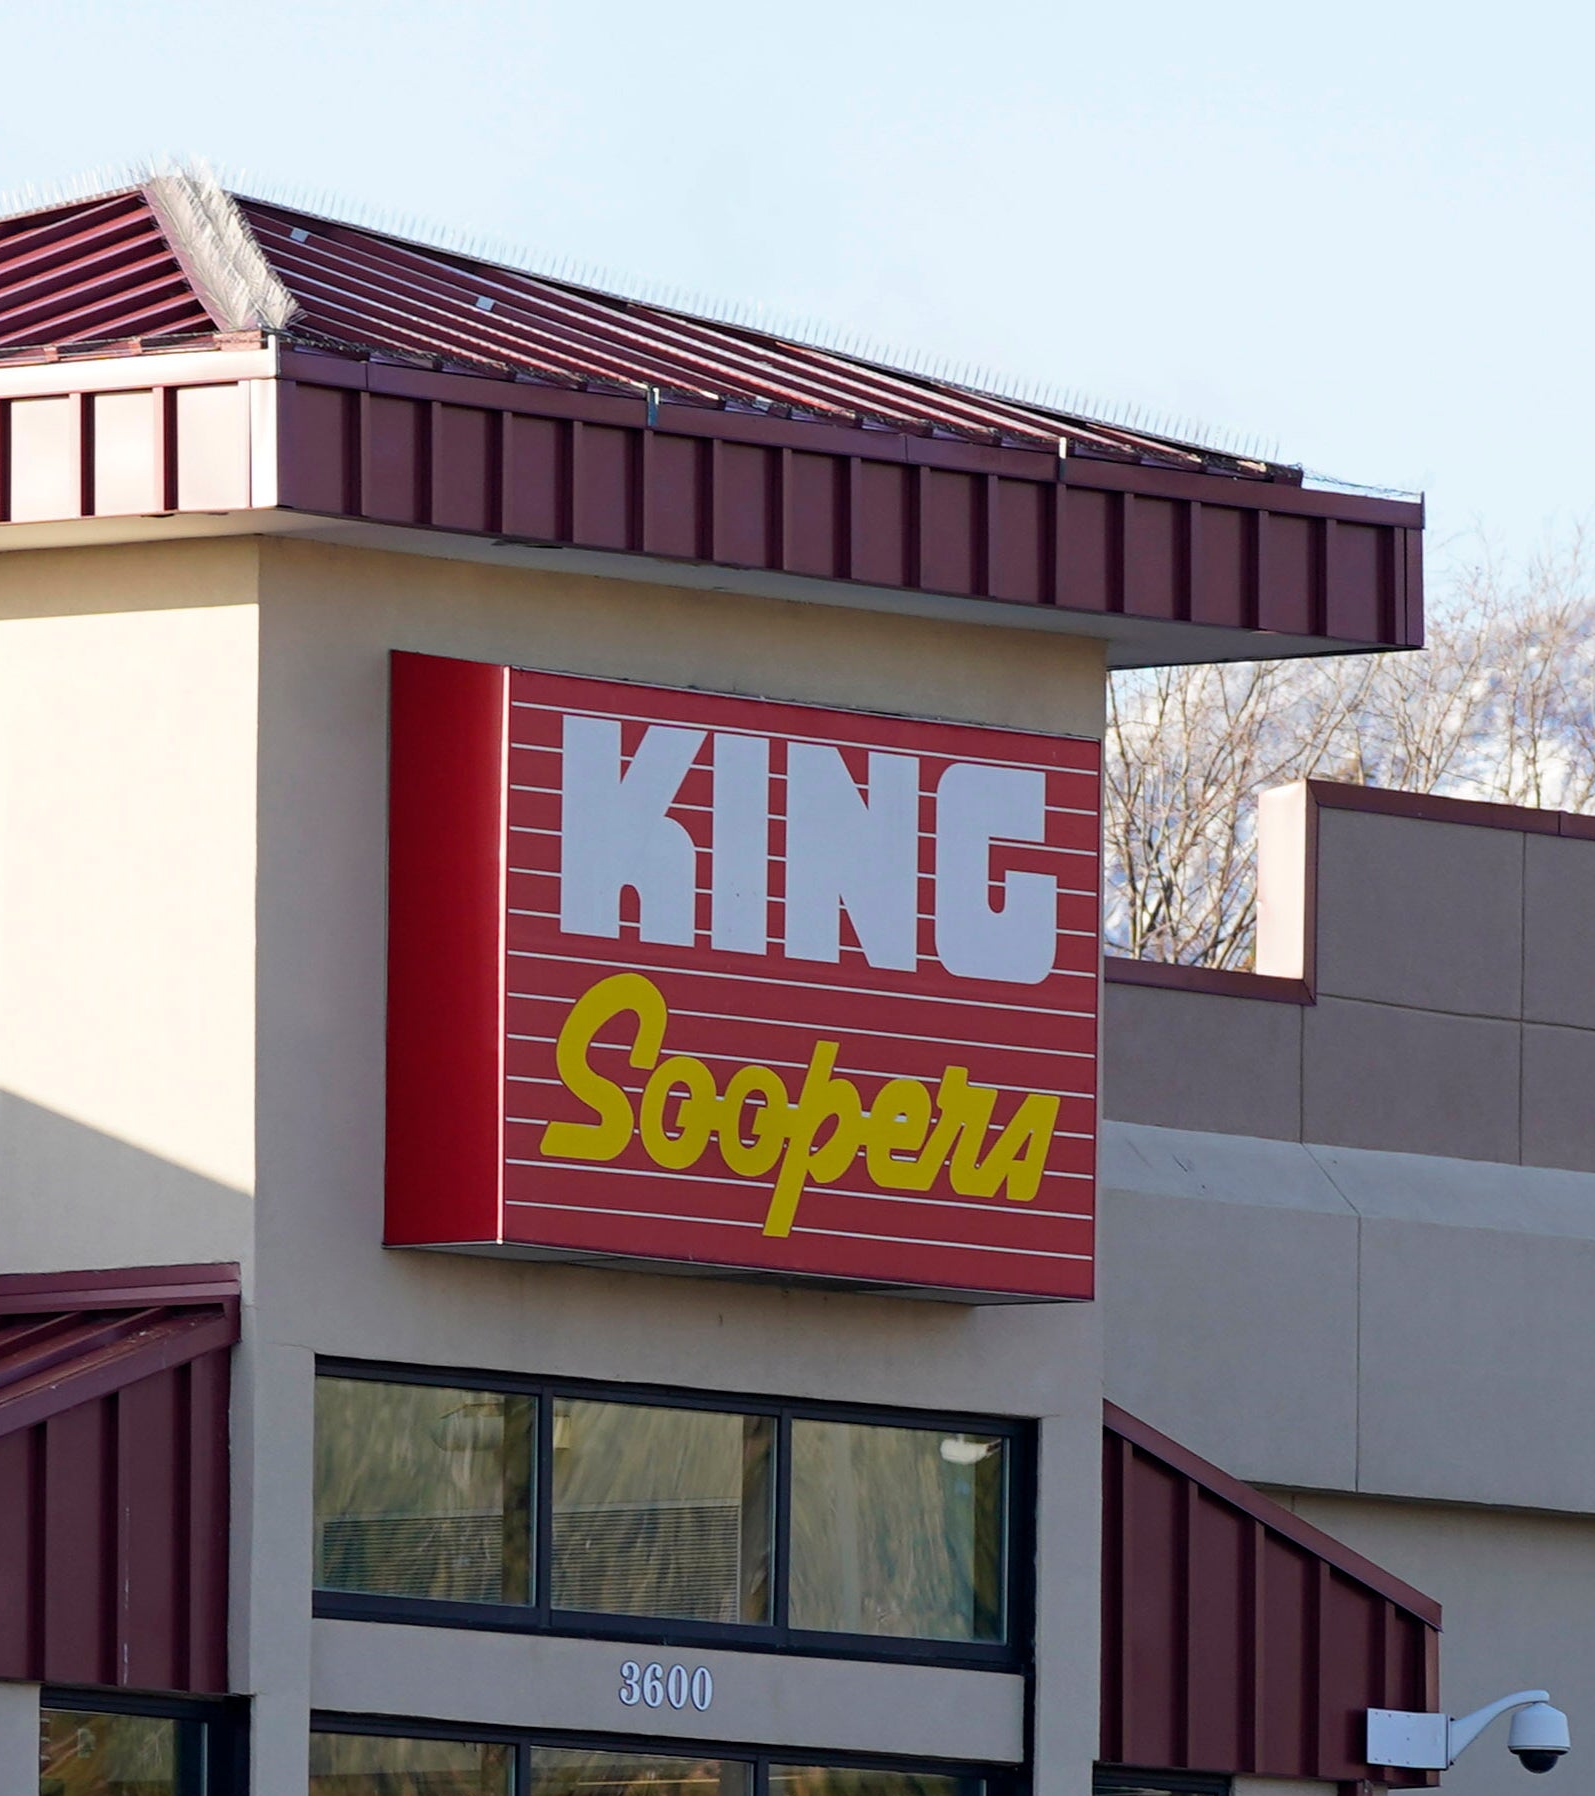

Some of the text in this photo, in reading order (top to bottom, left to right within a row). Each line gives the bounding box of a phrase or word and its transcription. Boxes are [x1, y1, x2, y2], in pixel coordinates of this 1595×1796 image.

[560, 714, 1057, 985] KING
[539, 973, 1061, 1239] Soopers
[619, 1660, 713, 1712] 3600
